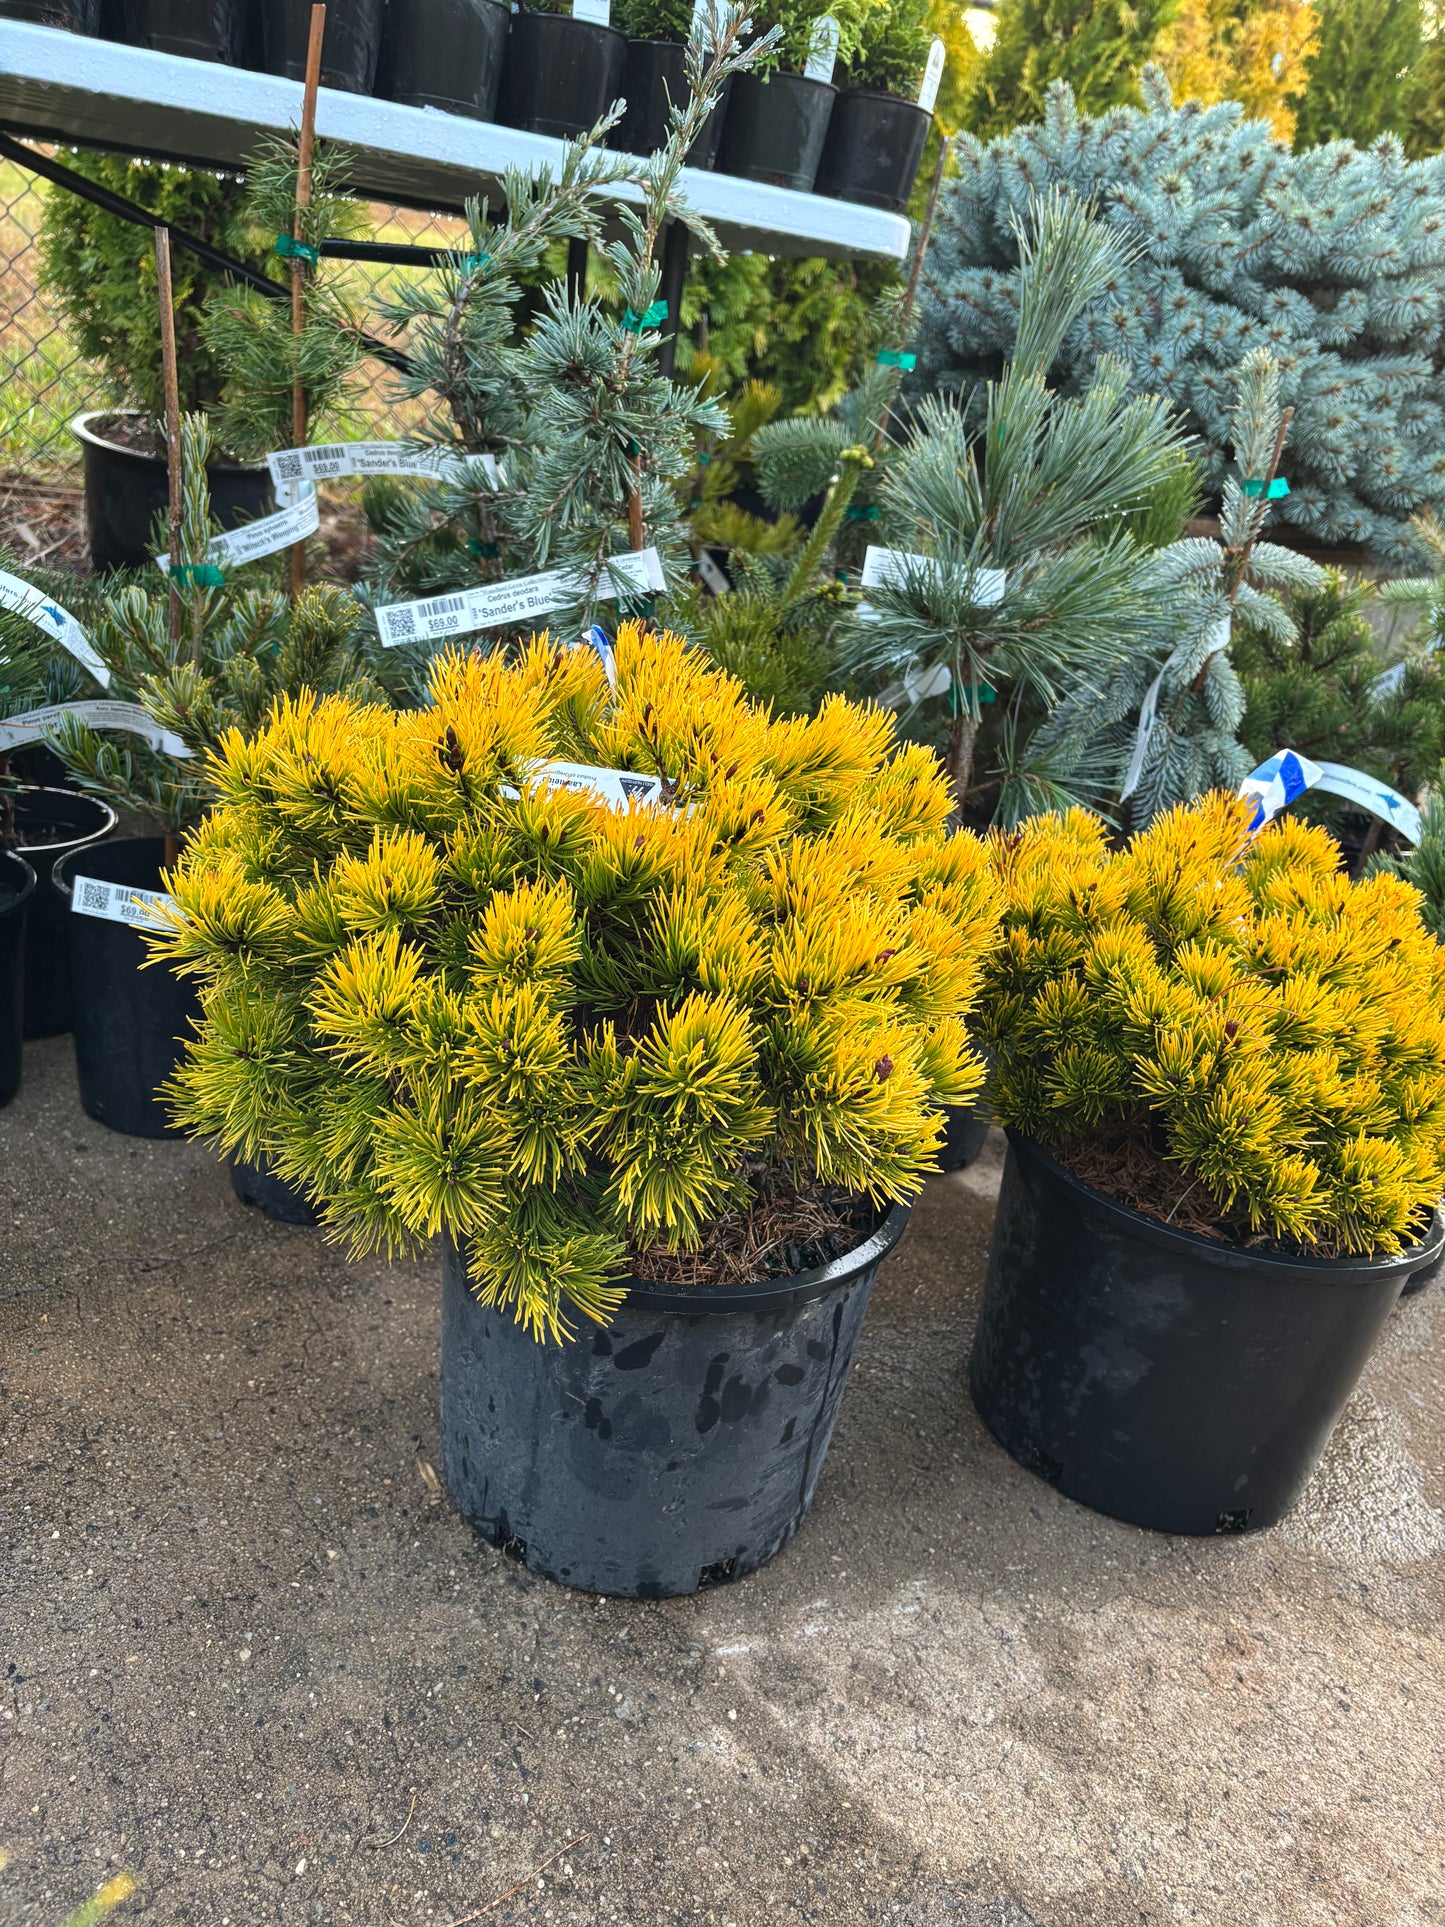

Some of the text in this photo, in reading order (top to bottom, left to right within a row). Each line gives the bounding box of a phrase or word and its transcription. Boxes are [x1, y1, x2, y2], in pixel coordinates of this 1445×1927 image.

[487, 592, 511, 602] Cedrus
[512, 586, 539, 598] deodara
[478, 600, 525, 618] 'Sander's
[527, 592, 552, 608] Blue'
[428, 615, 459, 630] $69.00
